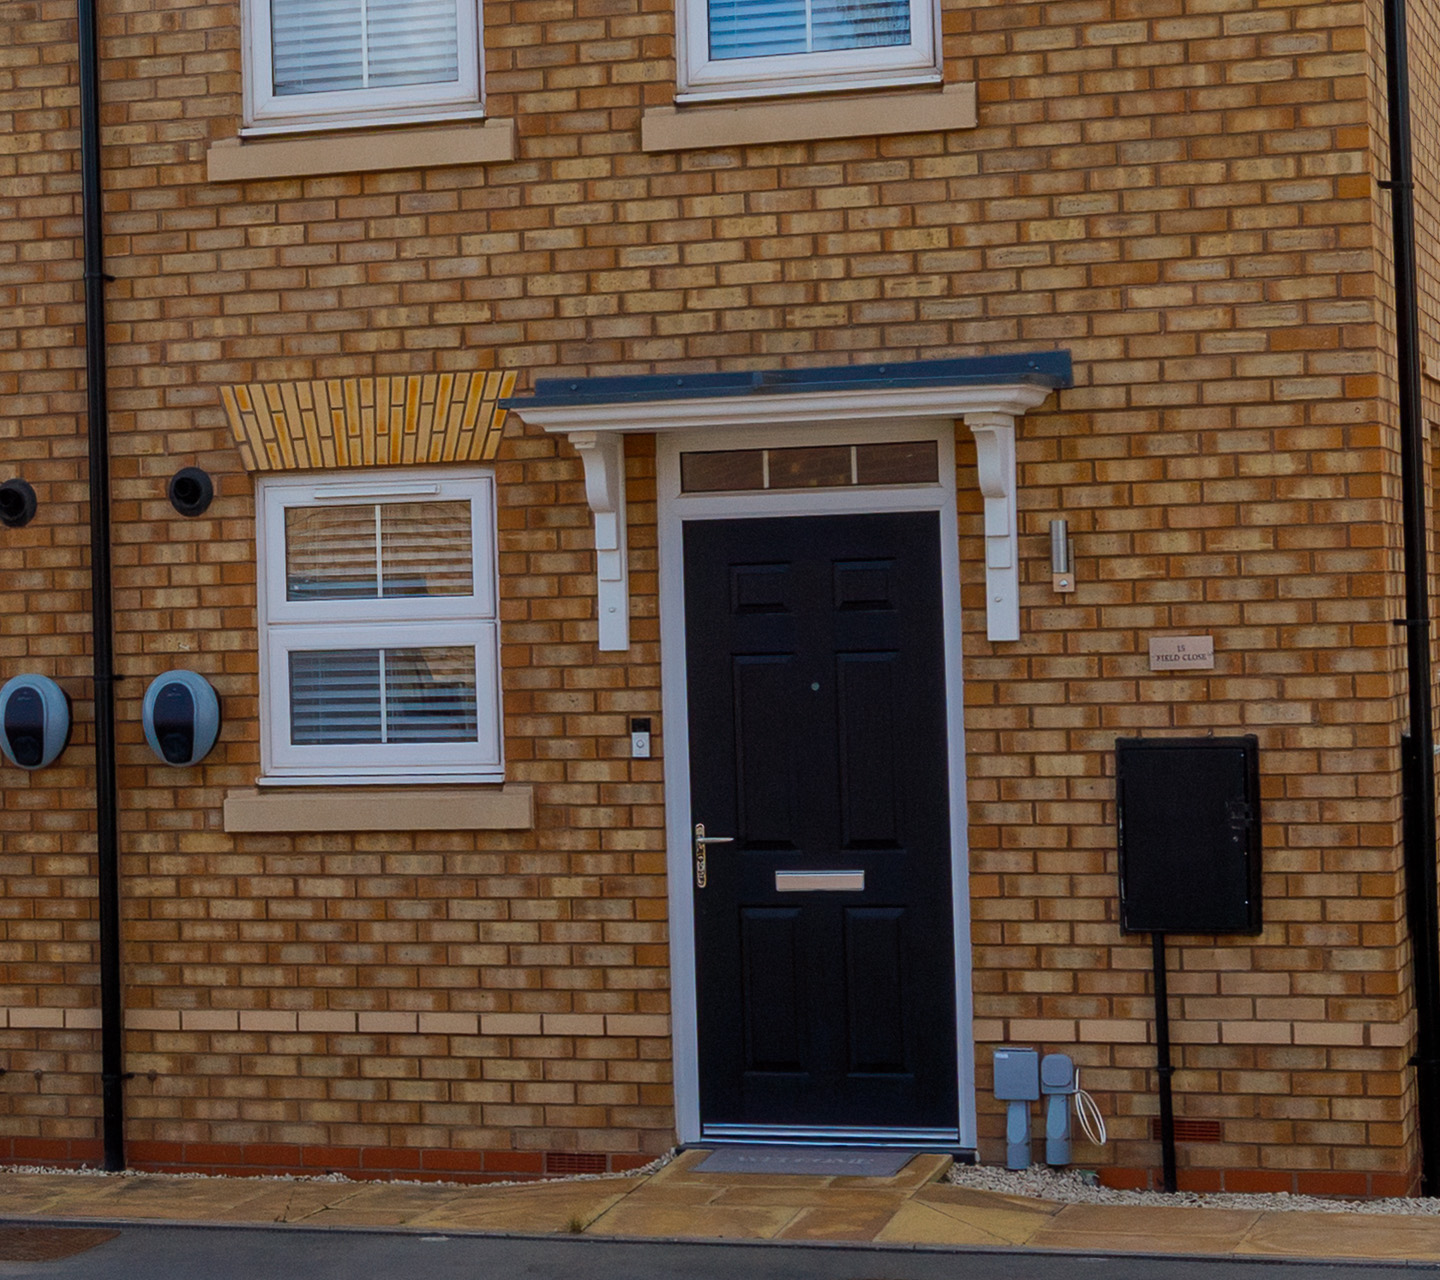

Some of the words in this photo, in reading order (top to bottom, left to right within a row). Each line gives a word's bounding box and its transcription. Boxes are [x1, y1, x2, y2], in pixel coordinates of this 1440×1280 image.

[1177, 644, 1186, 653] 15
[1156, 654, 1180, 662] FIELD
[1182, 653, 1207, 661] CLOSE
